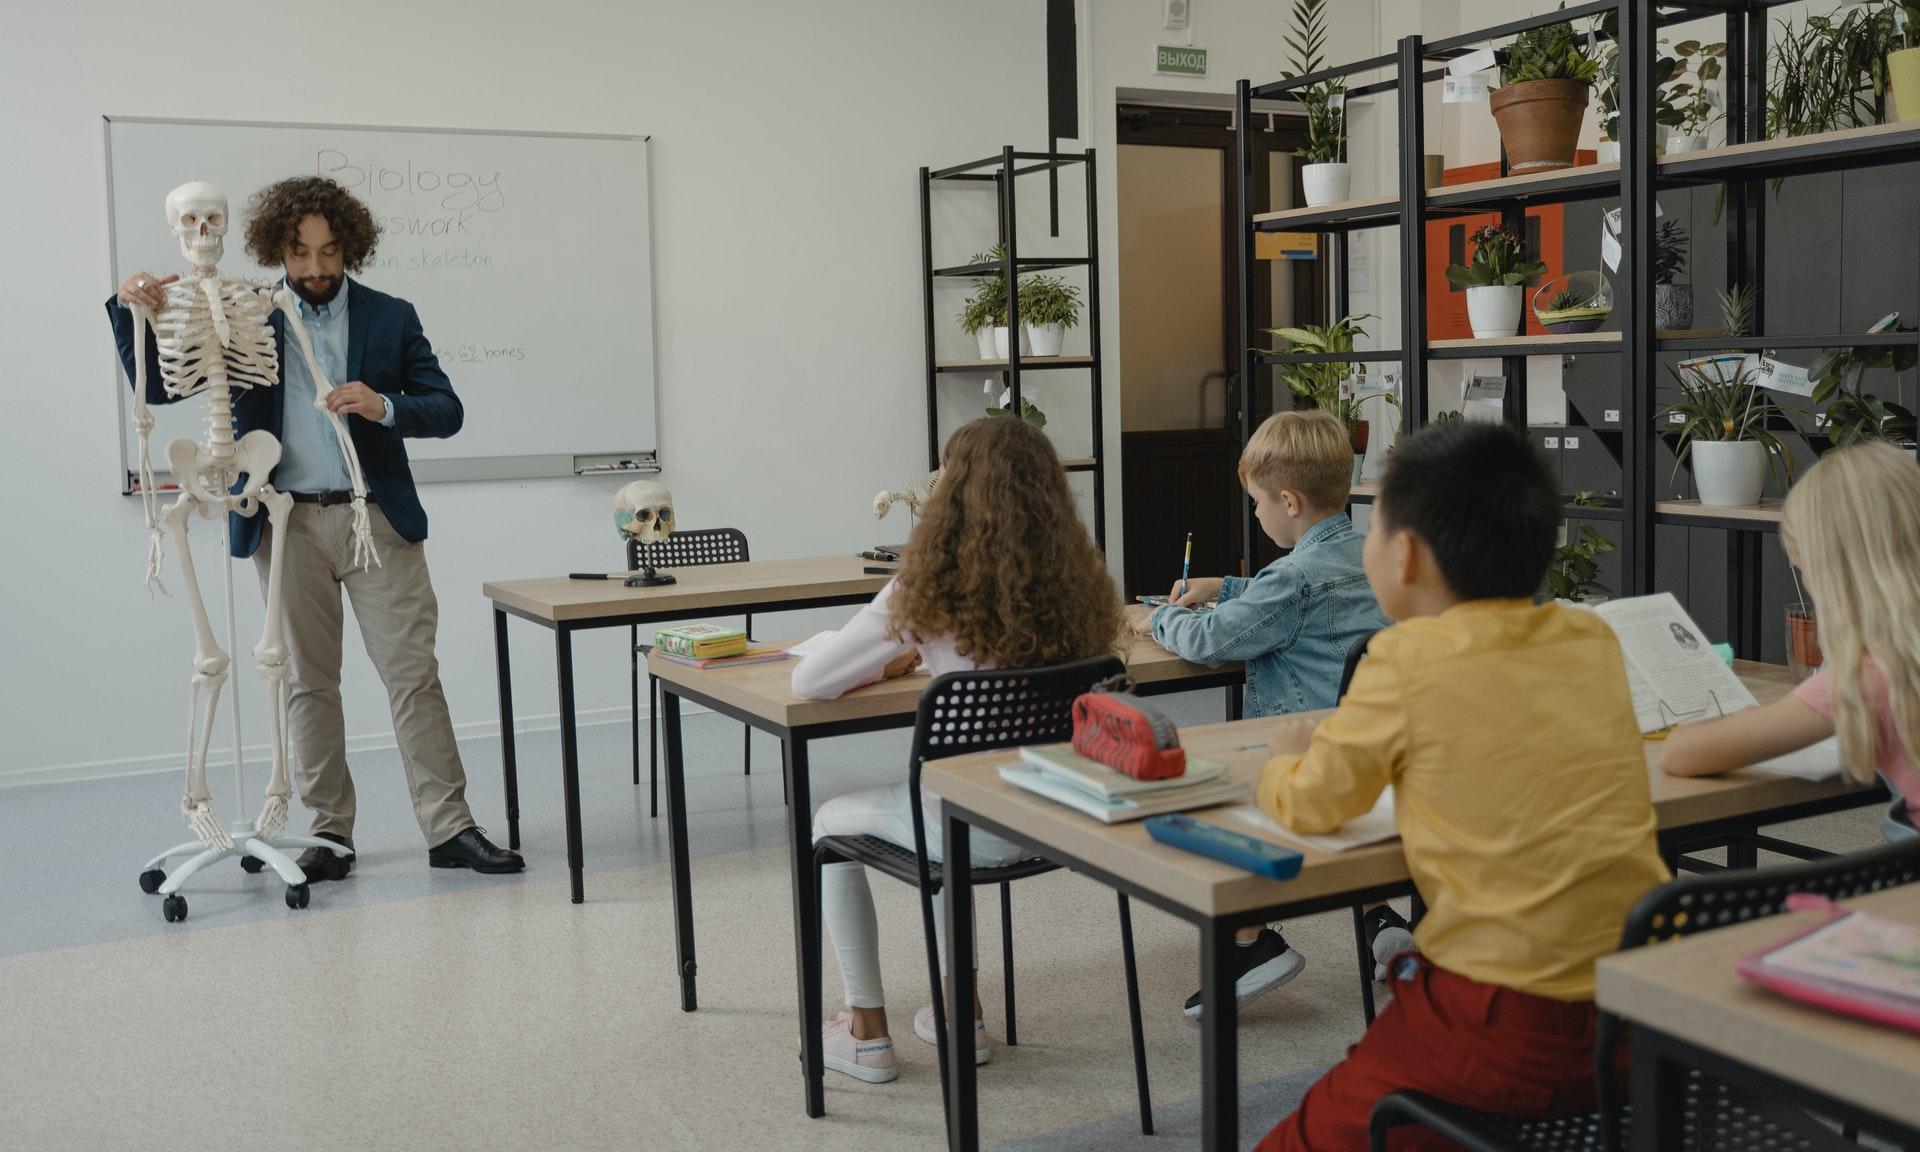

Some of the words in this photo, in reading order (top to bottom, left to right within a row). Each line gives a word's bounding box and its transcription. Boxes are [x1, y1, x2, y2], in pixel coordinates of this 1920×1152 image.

[1159, 51, 1206, 71] ВЫХОД
[317, 149, 505, 213] Biology
[377, 211, 473, 236] sswork
[406, 249, 494, 270] skeleton
[483, 345, 525, 361] bones
